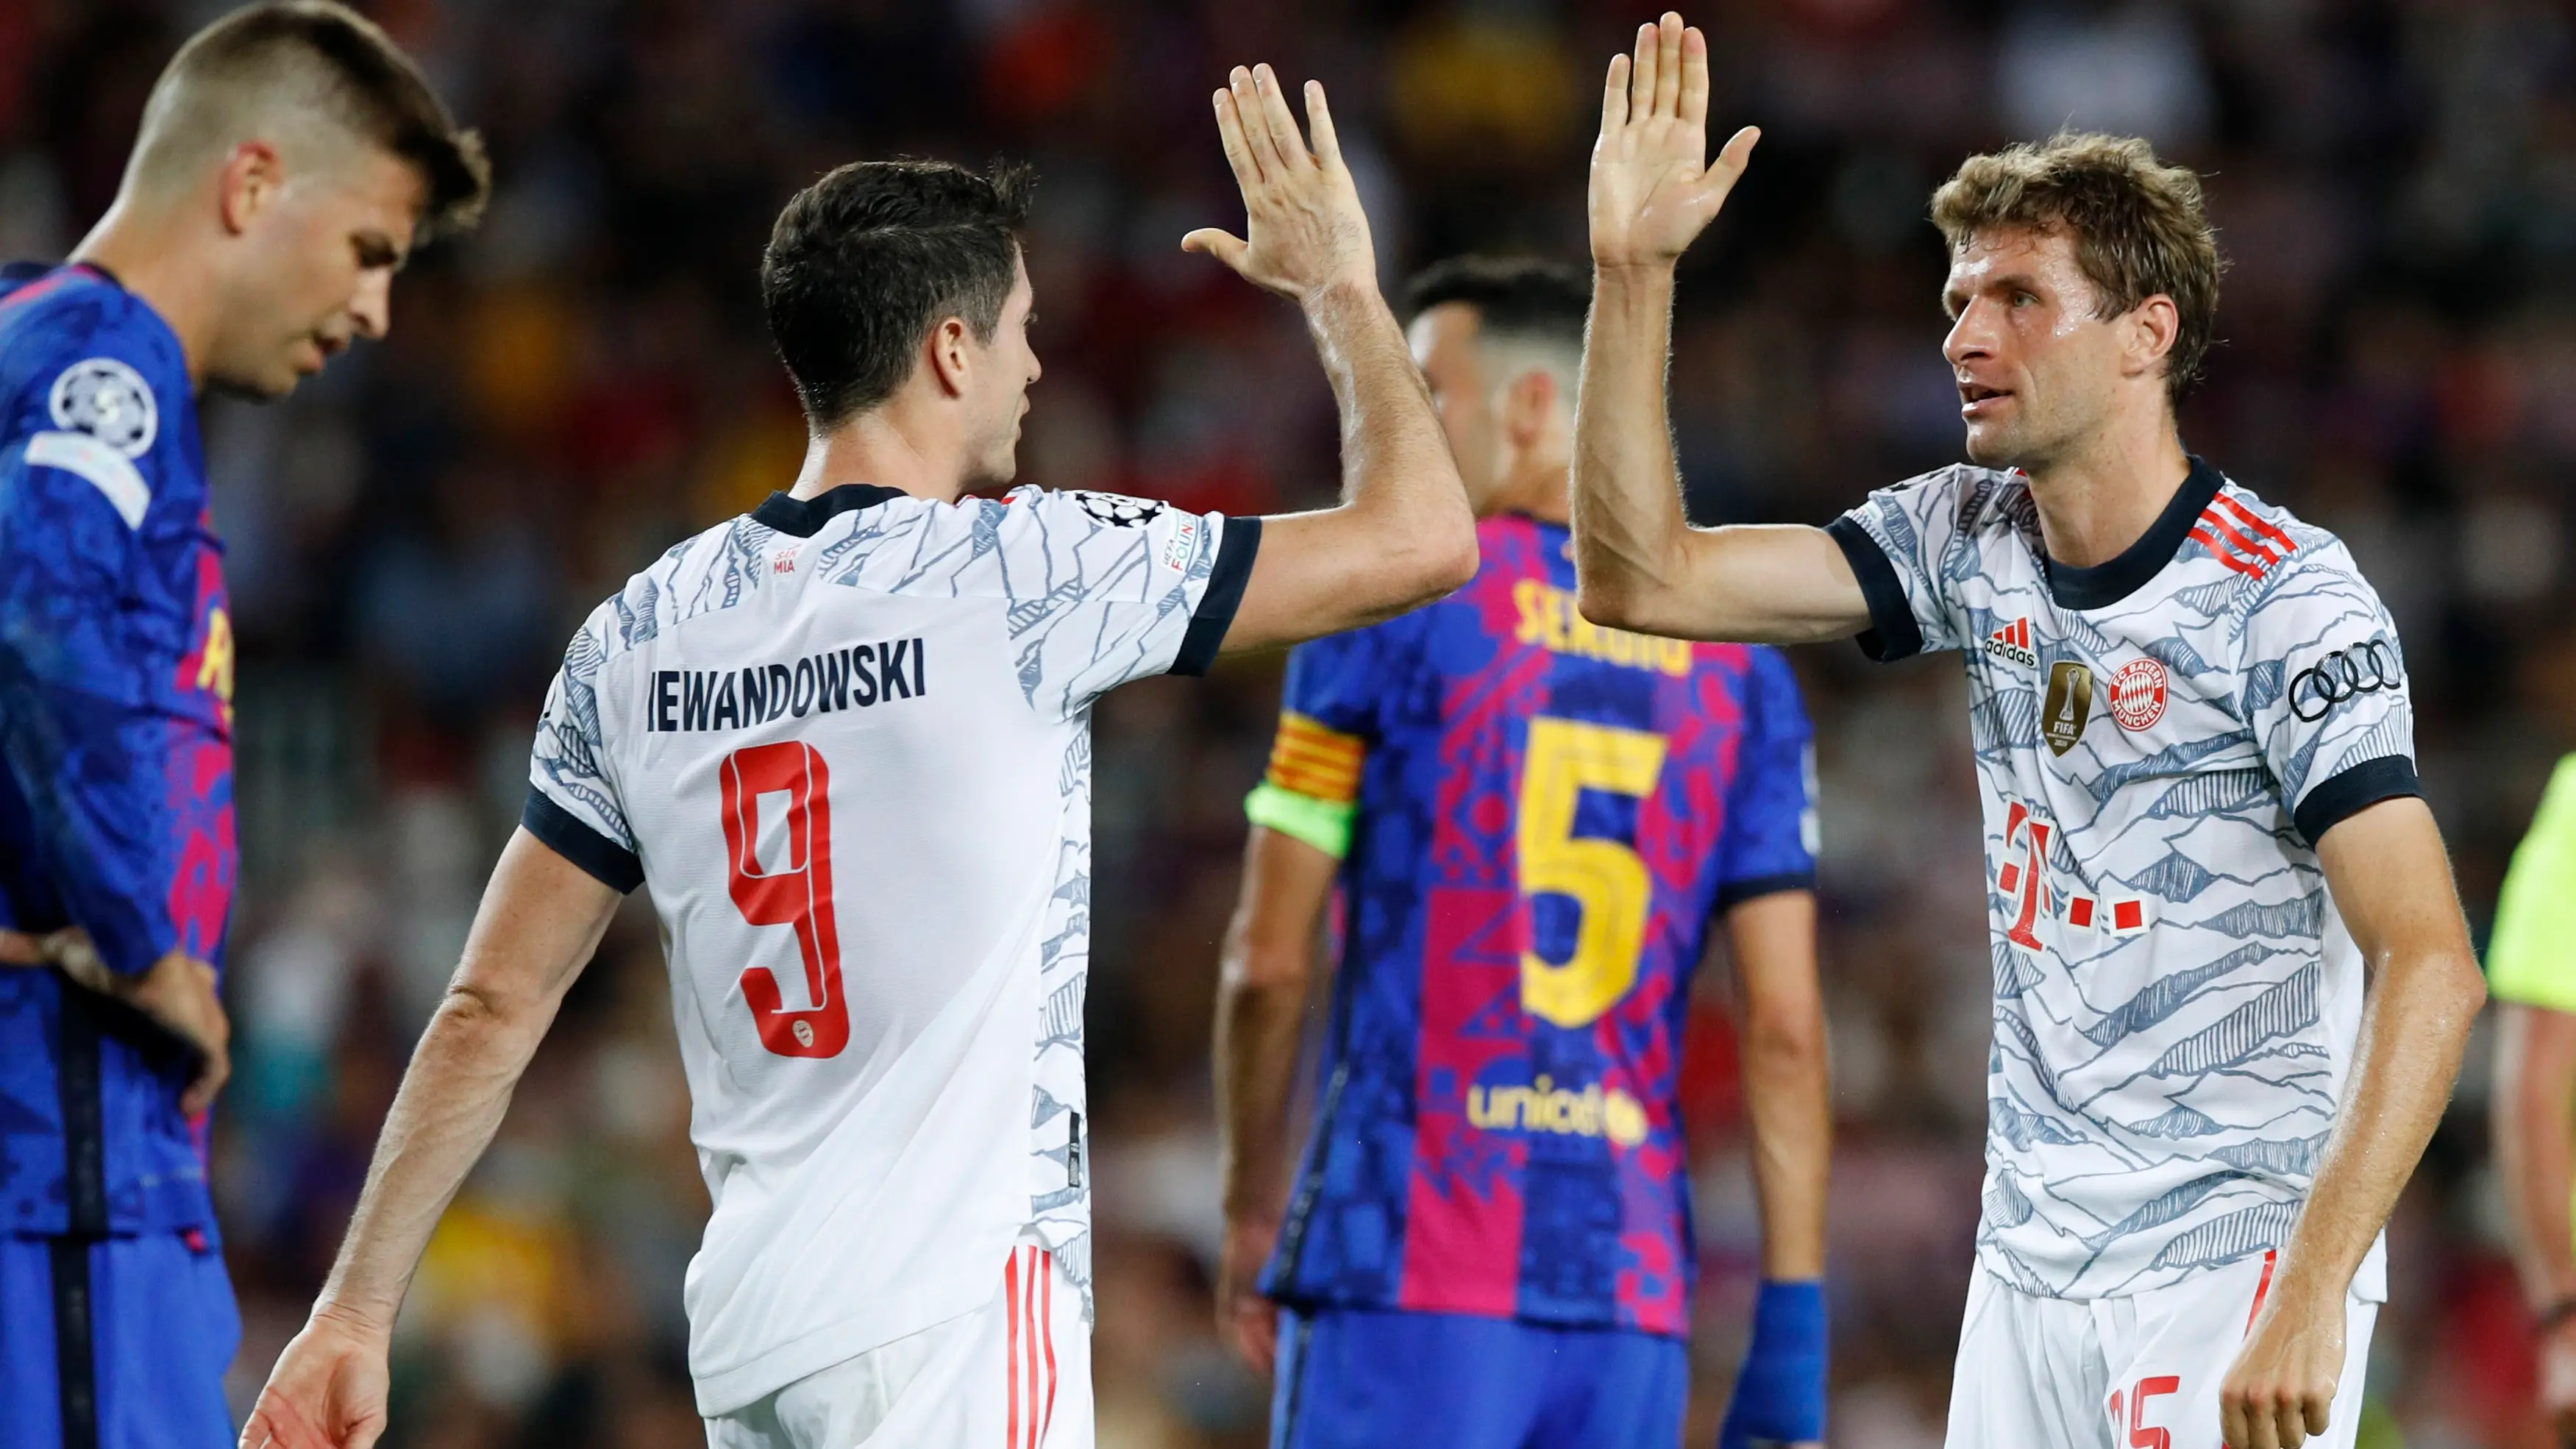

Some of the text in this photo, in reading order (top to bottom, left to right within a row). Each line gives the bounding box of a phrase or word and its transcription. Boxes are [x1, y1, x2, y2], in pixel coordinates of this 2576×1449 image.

[774, 560, 795, 574] MIA
[1985, 640, 2035, 666] adidas
[2113, 662, 2163, 688] FC BAYERN
[2053, 722, 2074, 736] FIFA
[1518, 716, 1669, 1028] 5
[719, 741, 850, 1058] 9
